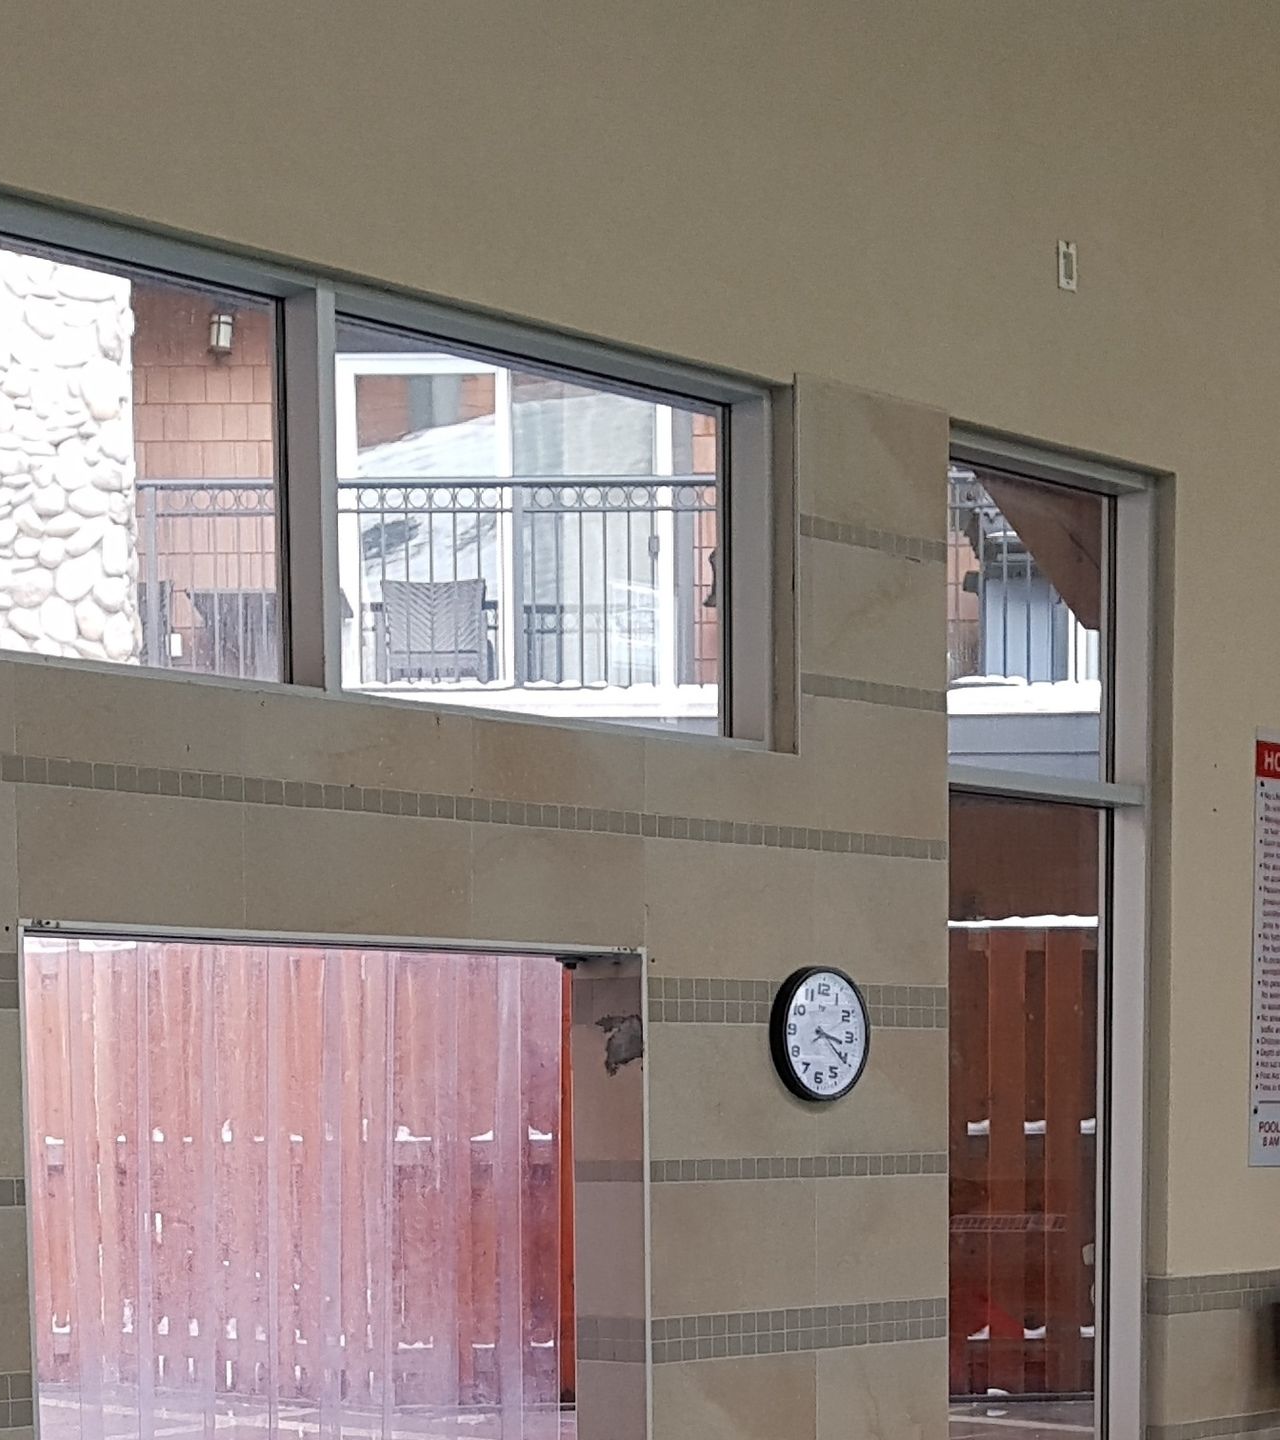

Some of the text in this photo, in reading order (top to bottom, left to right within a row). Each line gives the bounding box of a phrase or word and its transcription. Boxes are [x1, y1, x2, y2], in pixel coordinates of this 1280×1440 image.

[805, 988, 815, 1002] 11
[818, 982, 831, 997] 12
[793, 1003, 806, 1016] 10
[841, 1009, 851, 1022] 2
[787, 1023, 797, 1036] 9
[845, 1031, 854, 1044] 3
[791, 1045, 800, 1058] 8
[801, 1061, 811, 1074] 7
[828, 1066, 839, 1079] 5
[814, 1071, 823, 1084] 6
[1258, 1121, 1280, 1133] POOL
[1269, 1136, 1280, 1147] AM
